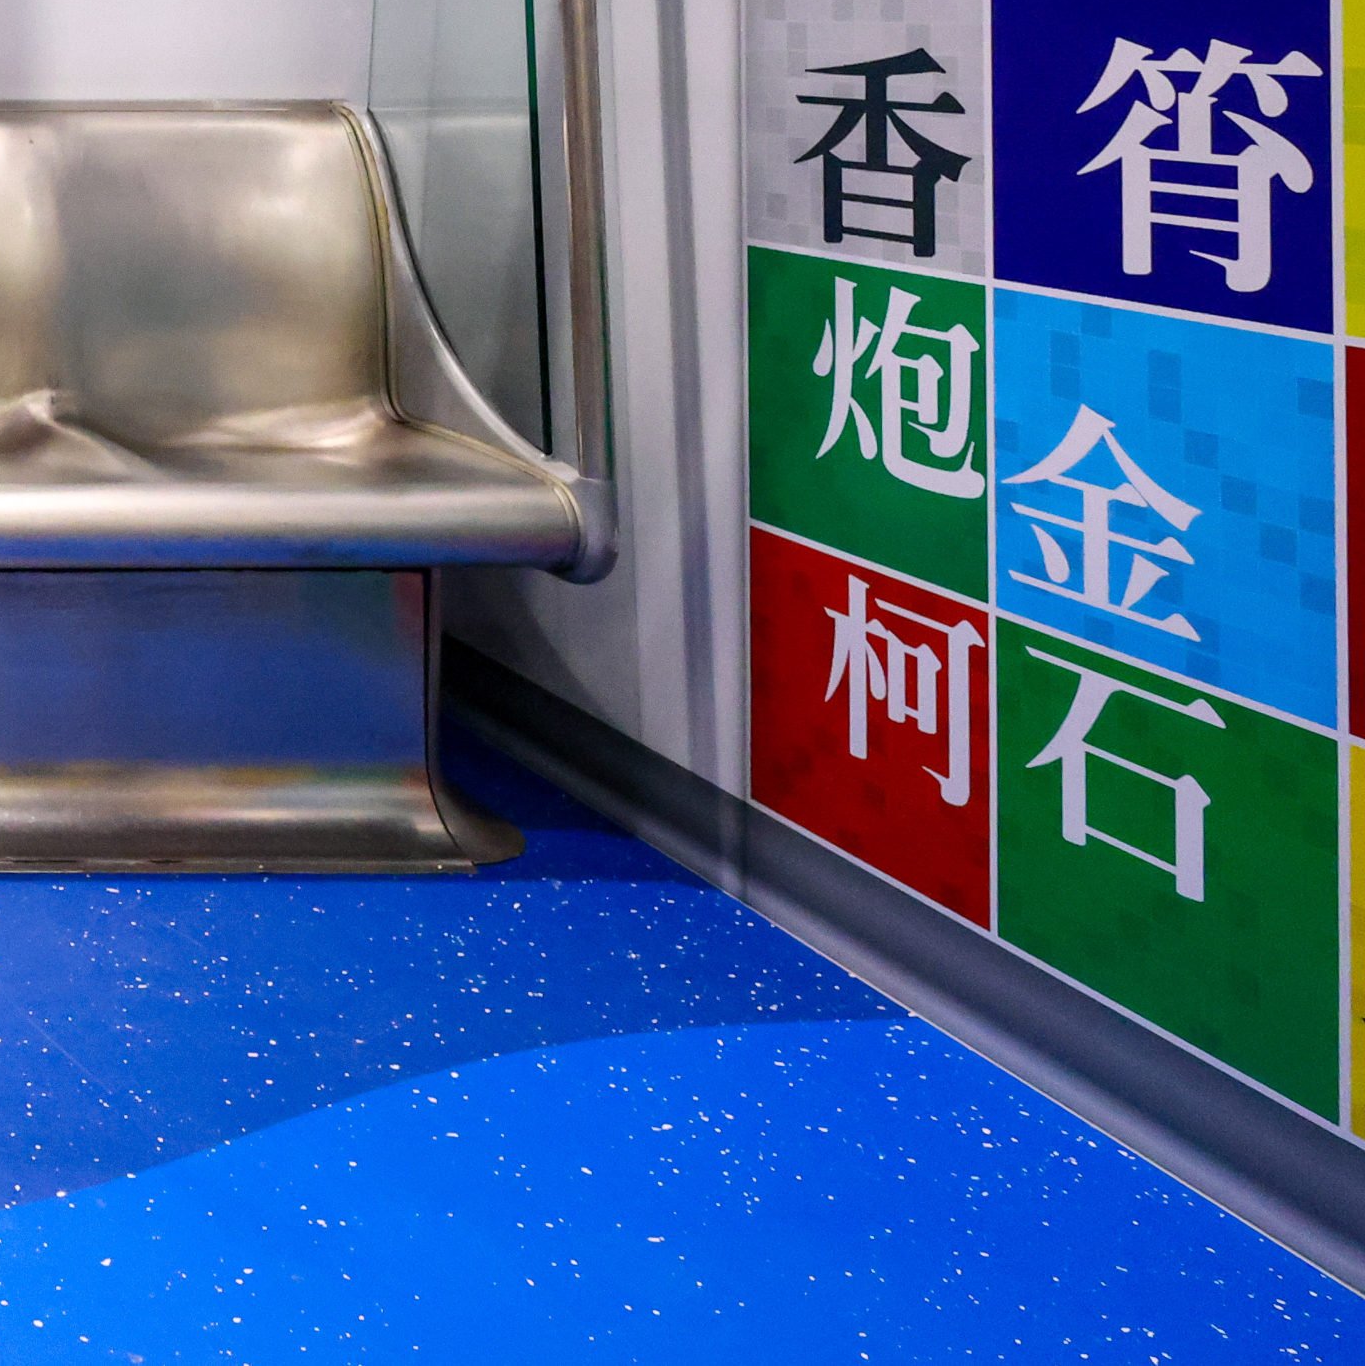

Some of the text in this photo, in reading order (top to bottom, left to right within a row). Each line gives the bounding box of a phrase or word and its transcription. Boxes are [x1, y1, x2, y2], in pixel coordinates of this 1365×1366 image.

[794, 48, 972, 257] 香
[813, 276, 985, 499] 炮
[1002, 403, 1202, 642] 金
[823, 574, 985, 807] 柯
[1025, 645, 1227, 902] 石
